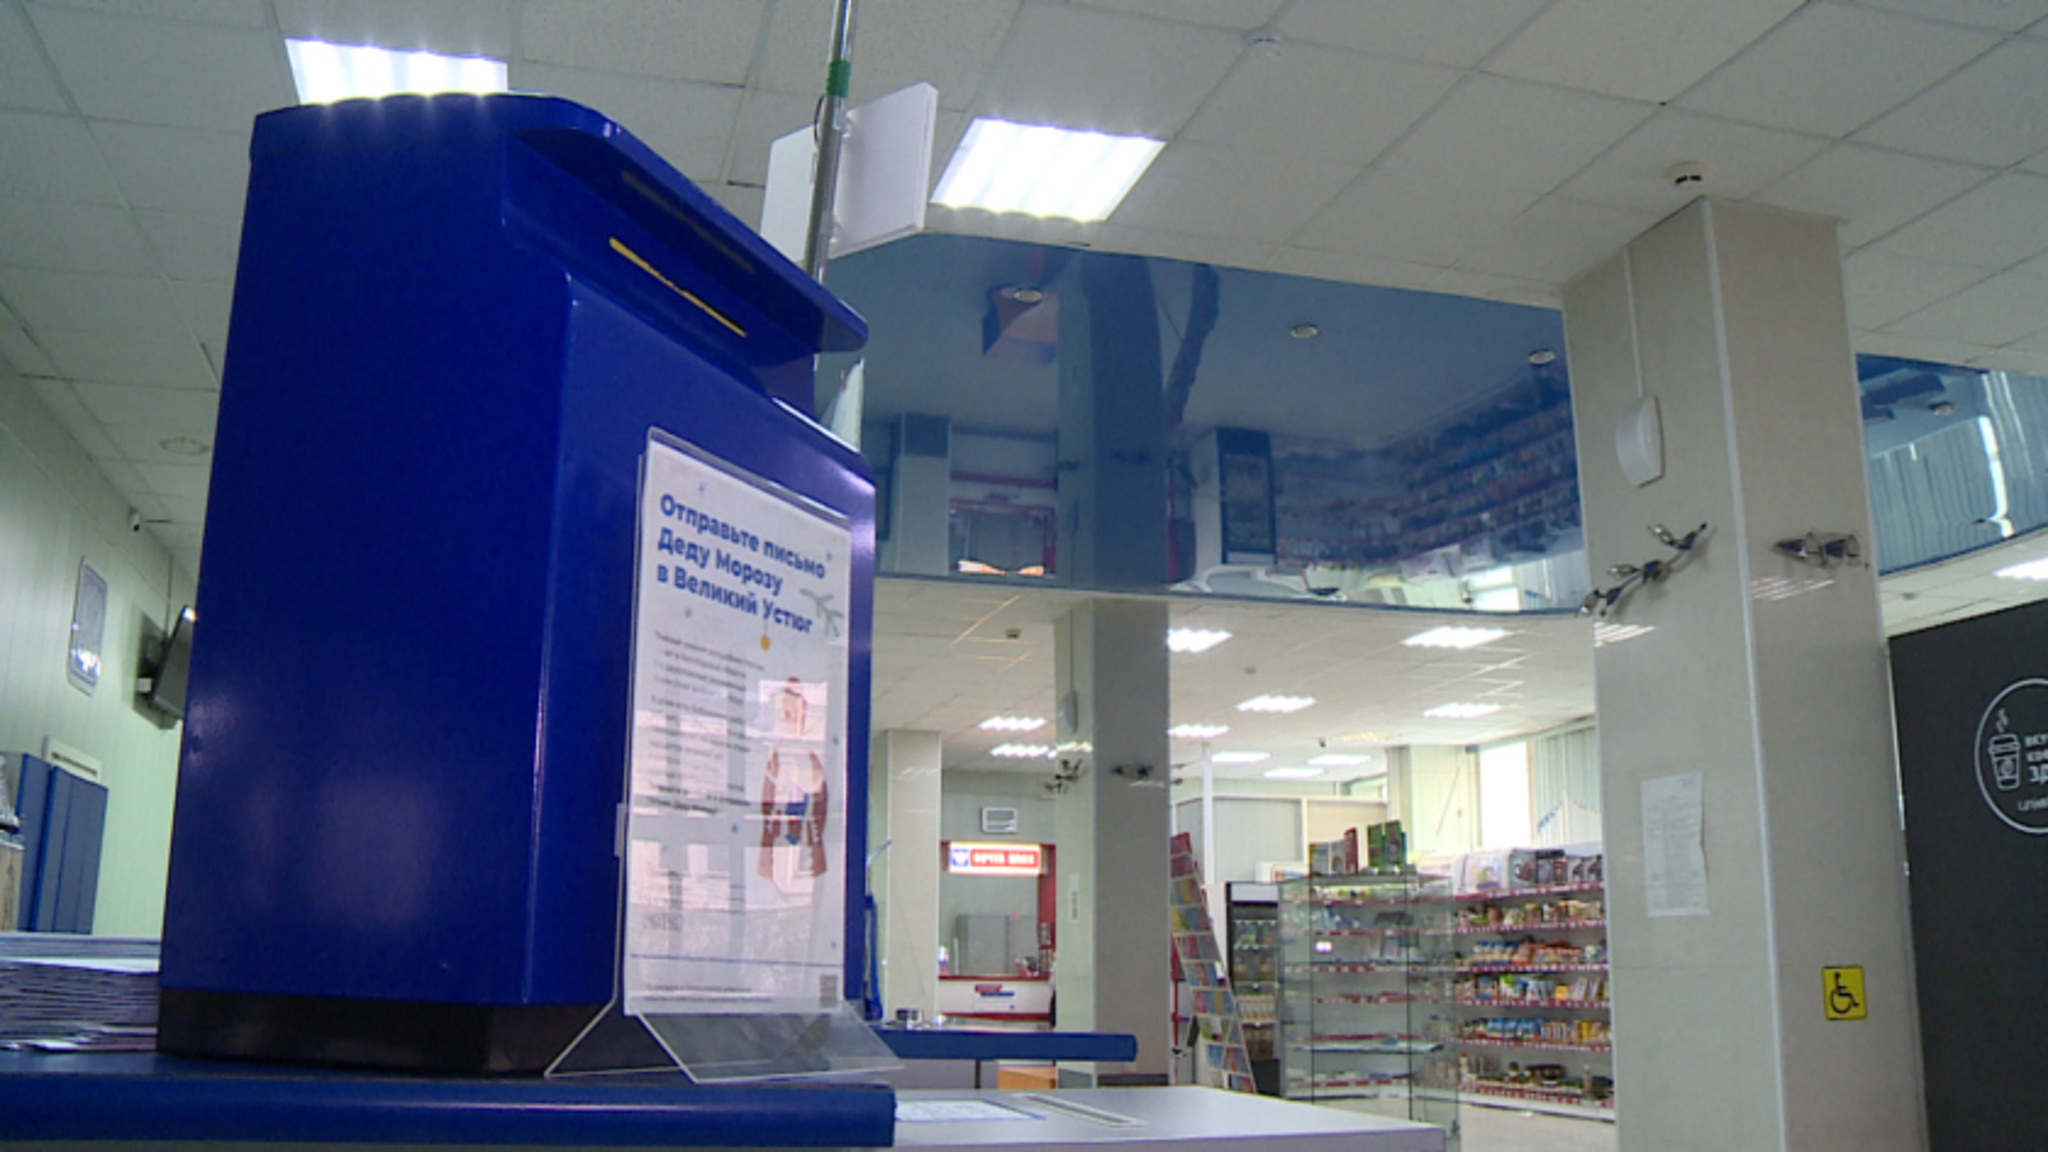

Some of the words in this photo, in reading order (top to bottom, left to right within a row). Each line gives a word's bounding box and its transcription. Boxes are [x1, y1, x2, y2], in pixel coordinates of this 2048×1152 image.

[658, 527, 711, 570] Деду
[715, 549, 784, 597] Морозу
[660, 493, 760, 552] Отправьте
[763, 540, 826, 580] письмо
[657, 564, 669, 583] в
[674, 565, 758, 616] Великий
[762, 598, 814, 635] Устюг
